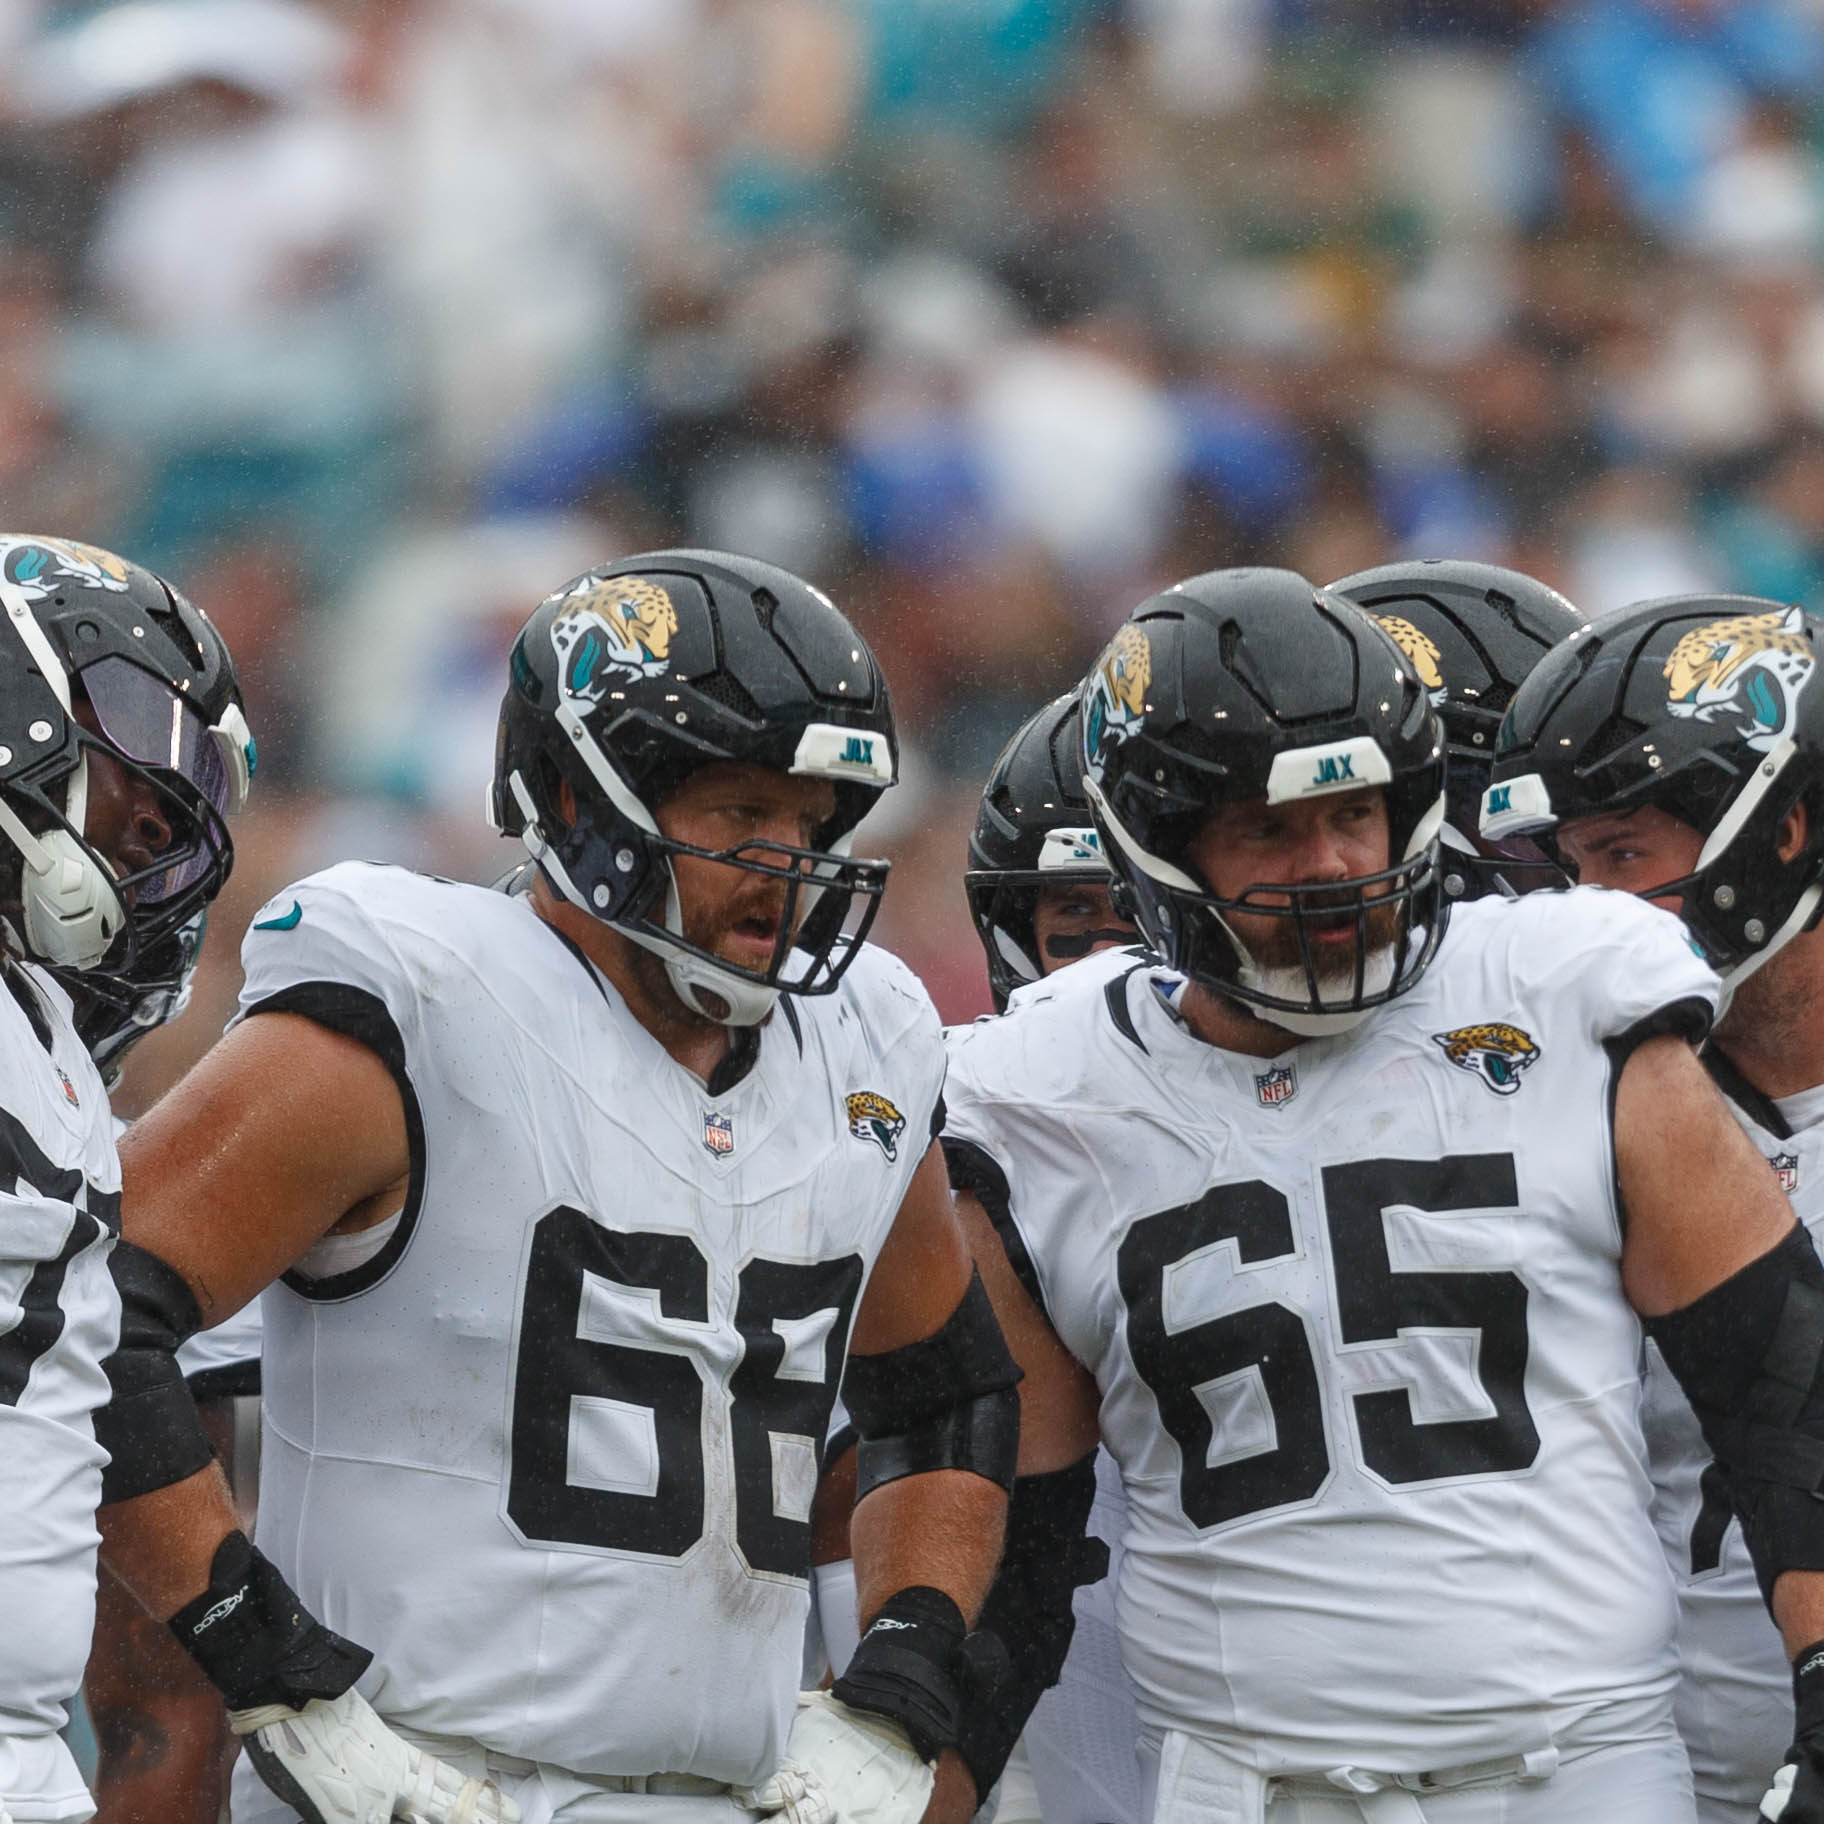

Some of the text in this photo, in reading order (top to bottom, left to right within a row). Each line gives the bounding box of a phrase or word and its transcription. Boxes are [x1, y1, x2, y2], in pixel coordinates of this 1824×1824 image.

[839, 736, 874, 765] JAX
[1312, 752, 1356, 785] JAX
[1260, 1080, 1292, 1102] NFL
[1116, 1150, 1542, 1531] 65
[506, 1203, 866, 1581] 68
